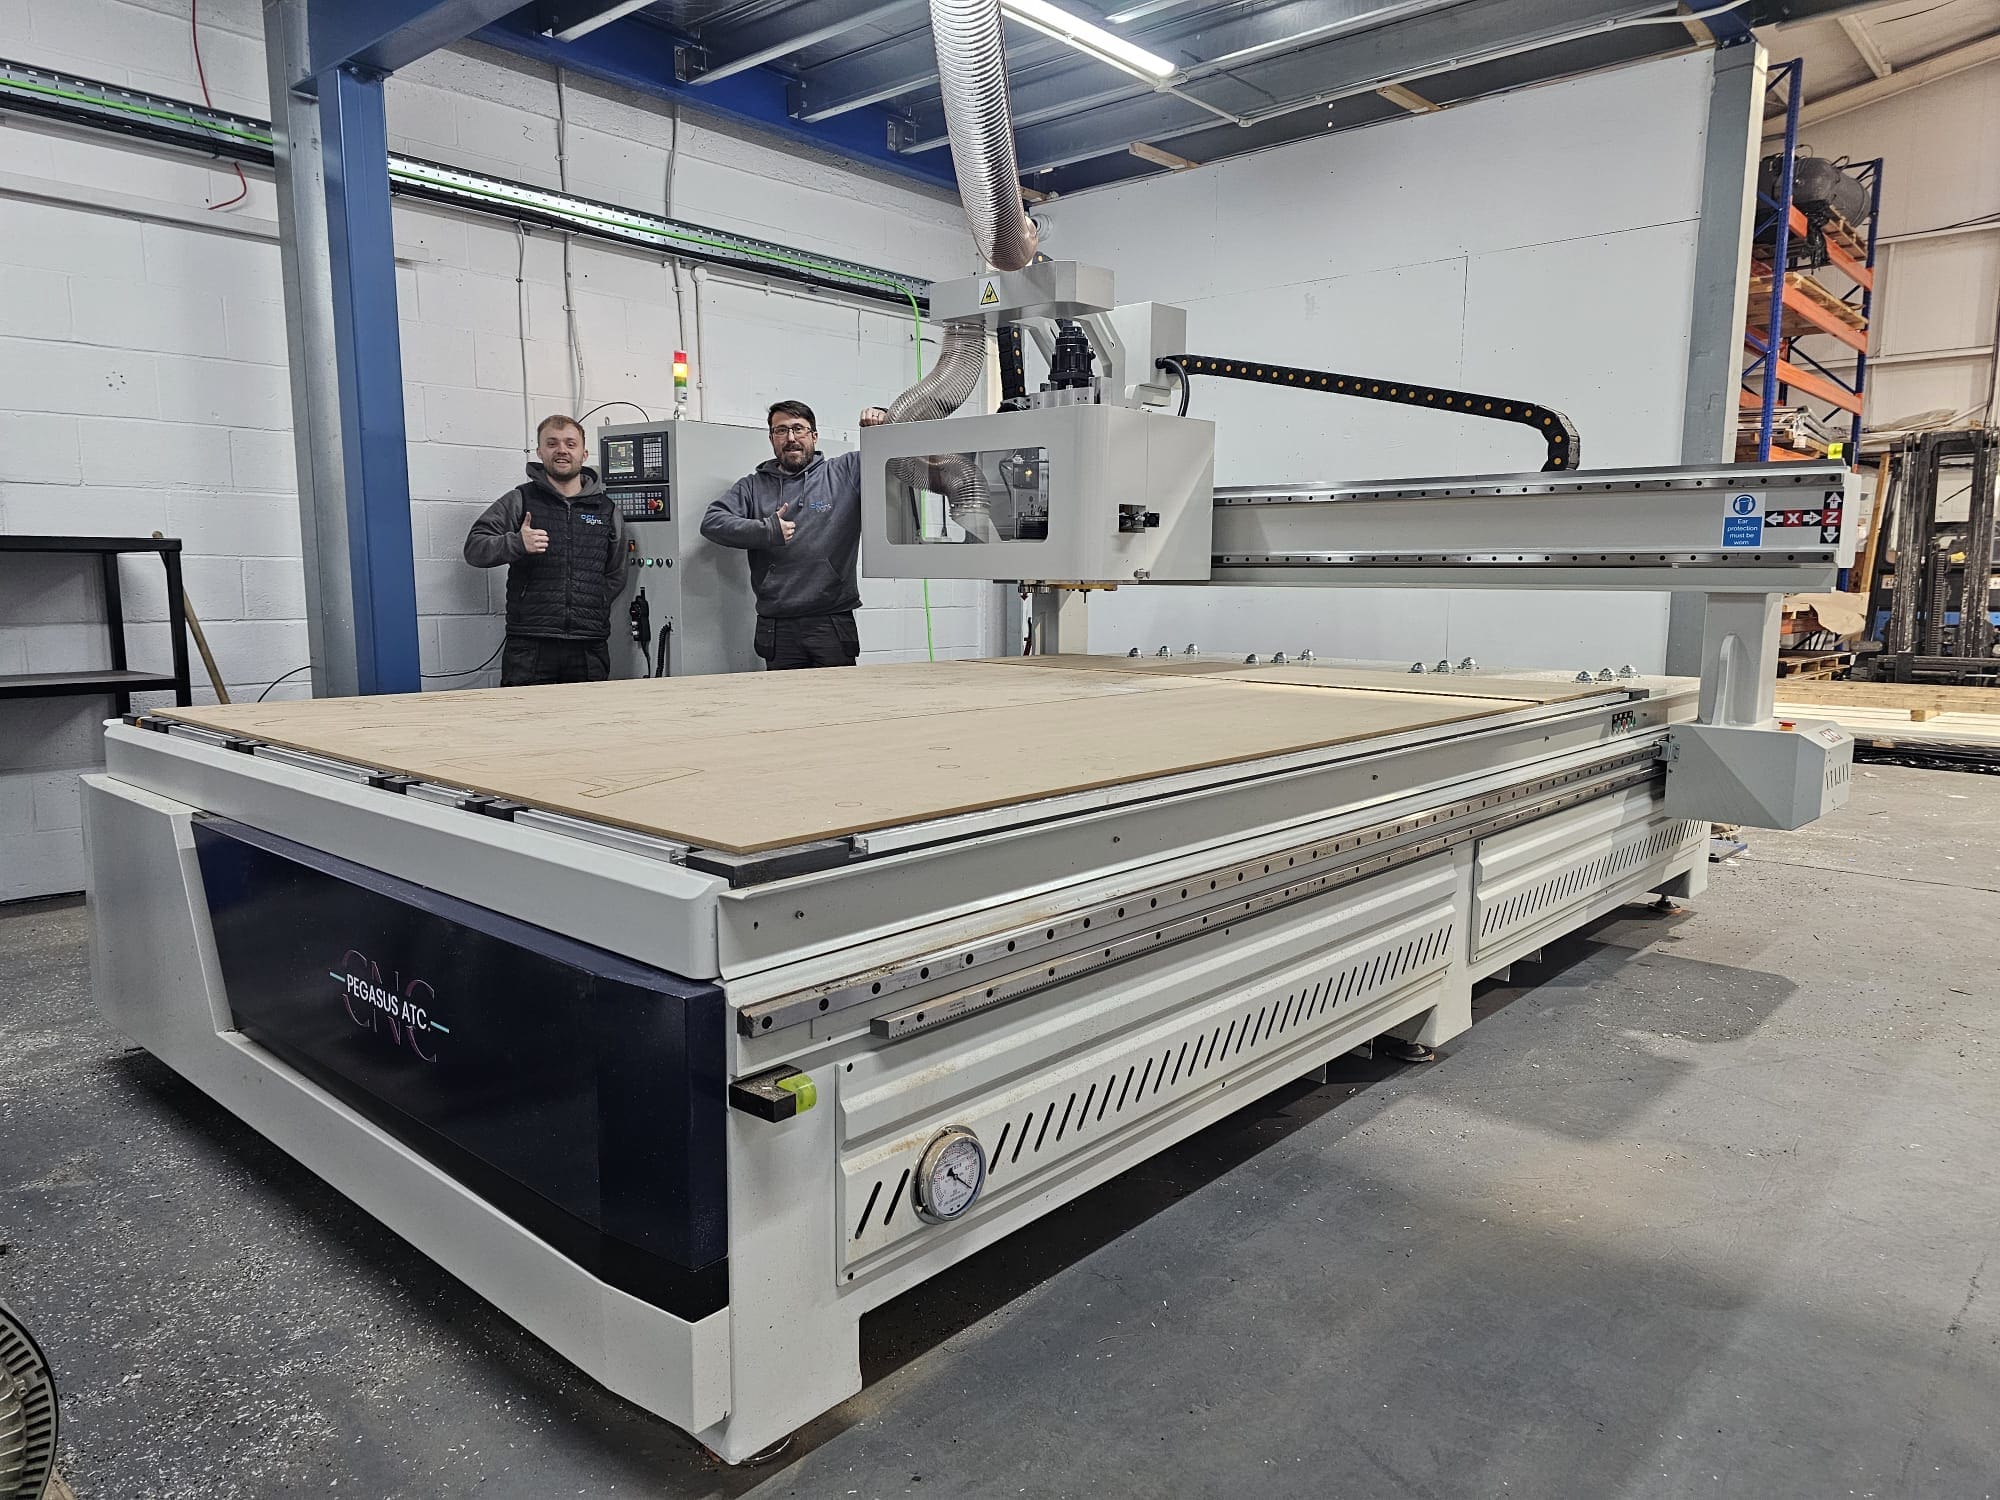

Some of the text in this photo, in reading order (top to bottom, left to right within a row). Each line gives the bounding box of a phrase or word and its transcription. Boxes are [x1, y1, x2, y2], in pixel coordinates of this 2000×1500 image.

[1786, 511, 1839, 524] X Z
[346, 973, 399, 1016] PEGASUS
